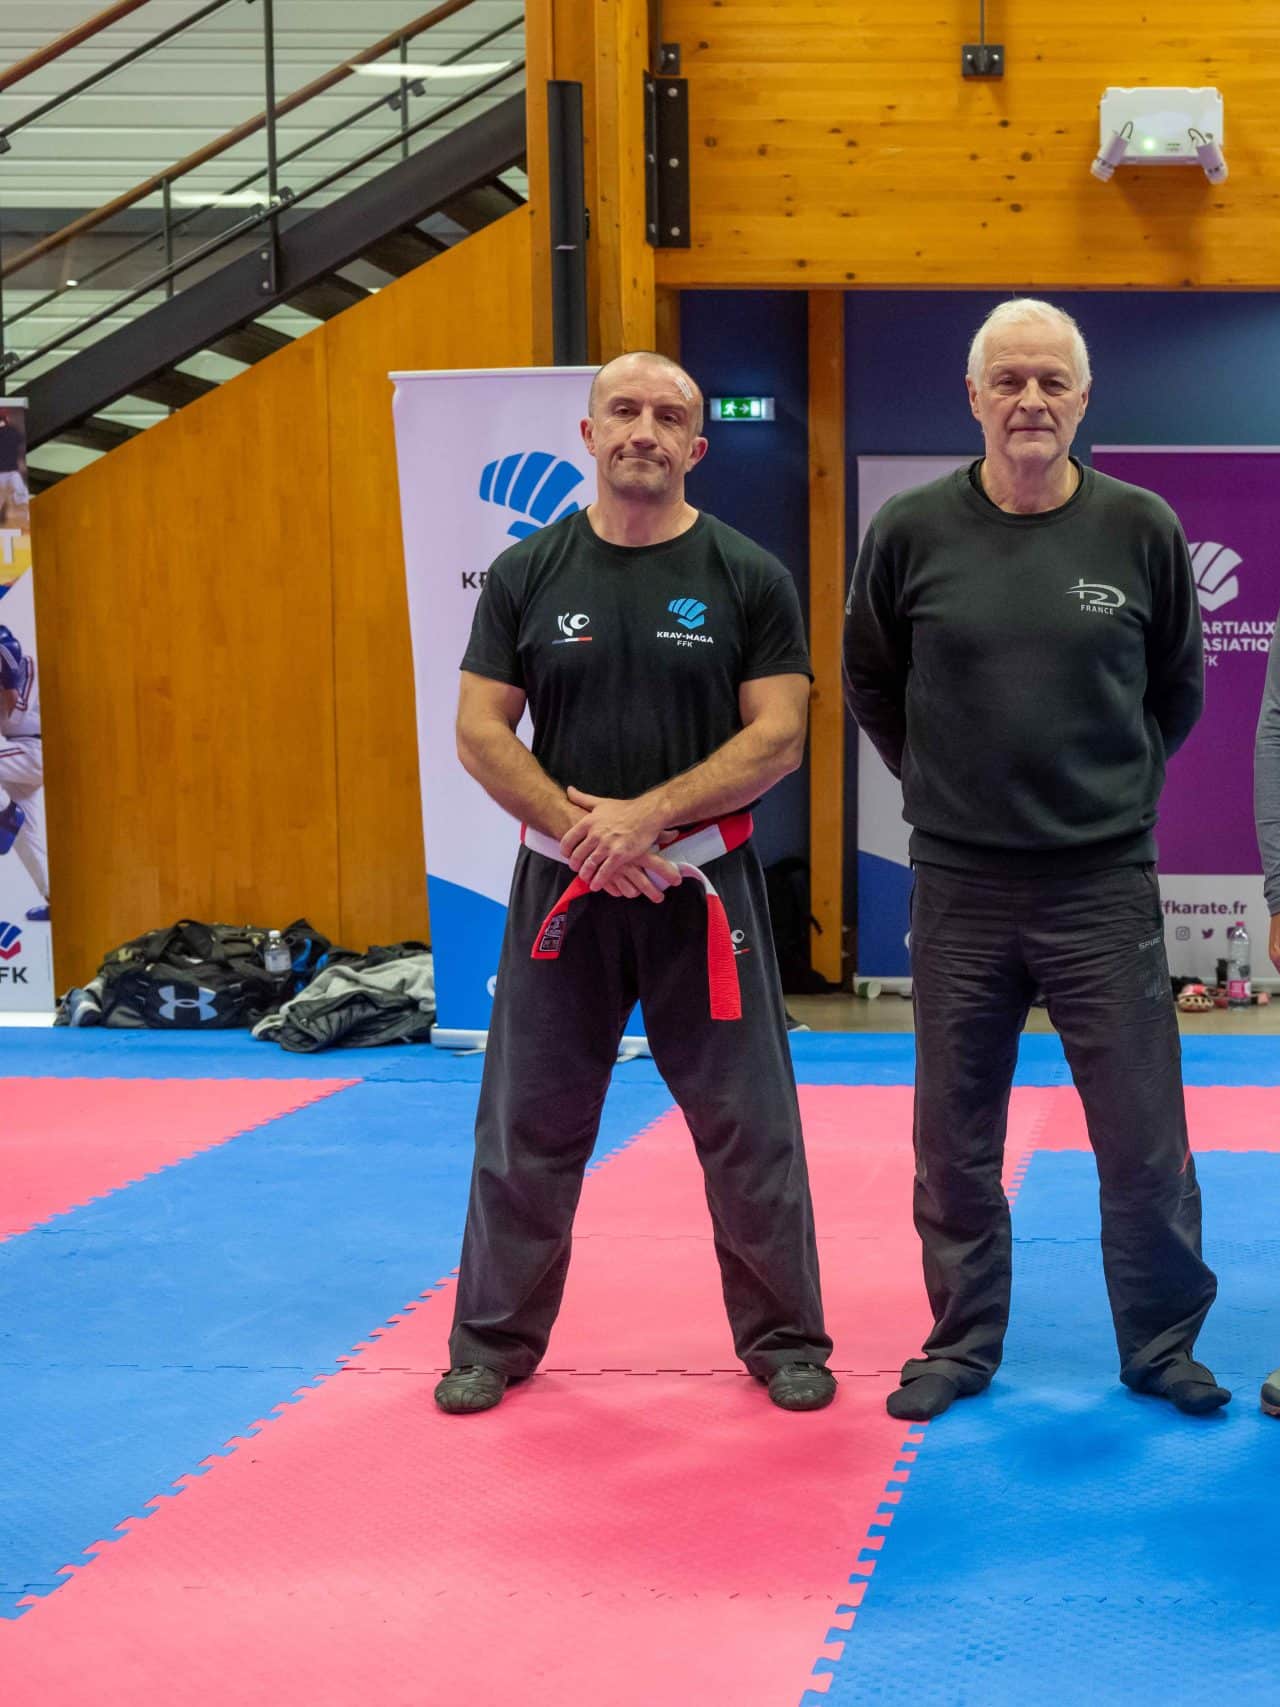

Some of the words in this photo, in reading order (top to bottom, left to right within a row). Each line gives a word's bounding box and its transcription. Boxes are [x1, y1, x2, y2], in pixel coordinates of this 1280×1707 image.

[1080, 604, 1114, 615] FRANCE
[656, 631, 714, 644] KRAV-MAGA
[677, 640, 693, 648] FFK
[1202, 638, 1272, 652] ASIATIQ
[1160, 900, 1247, 915] fkarate.fr
